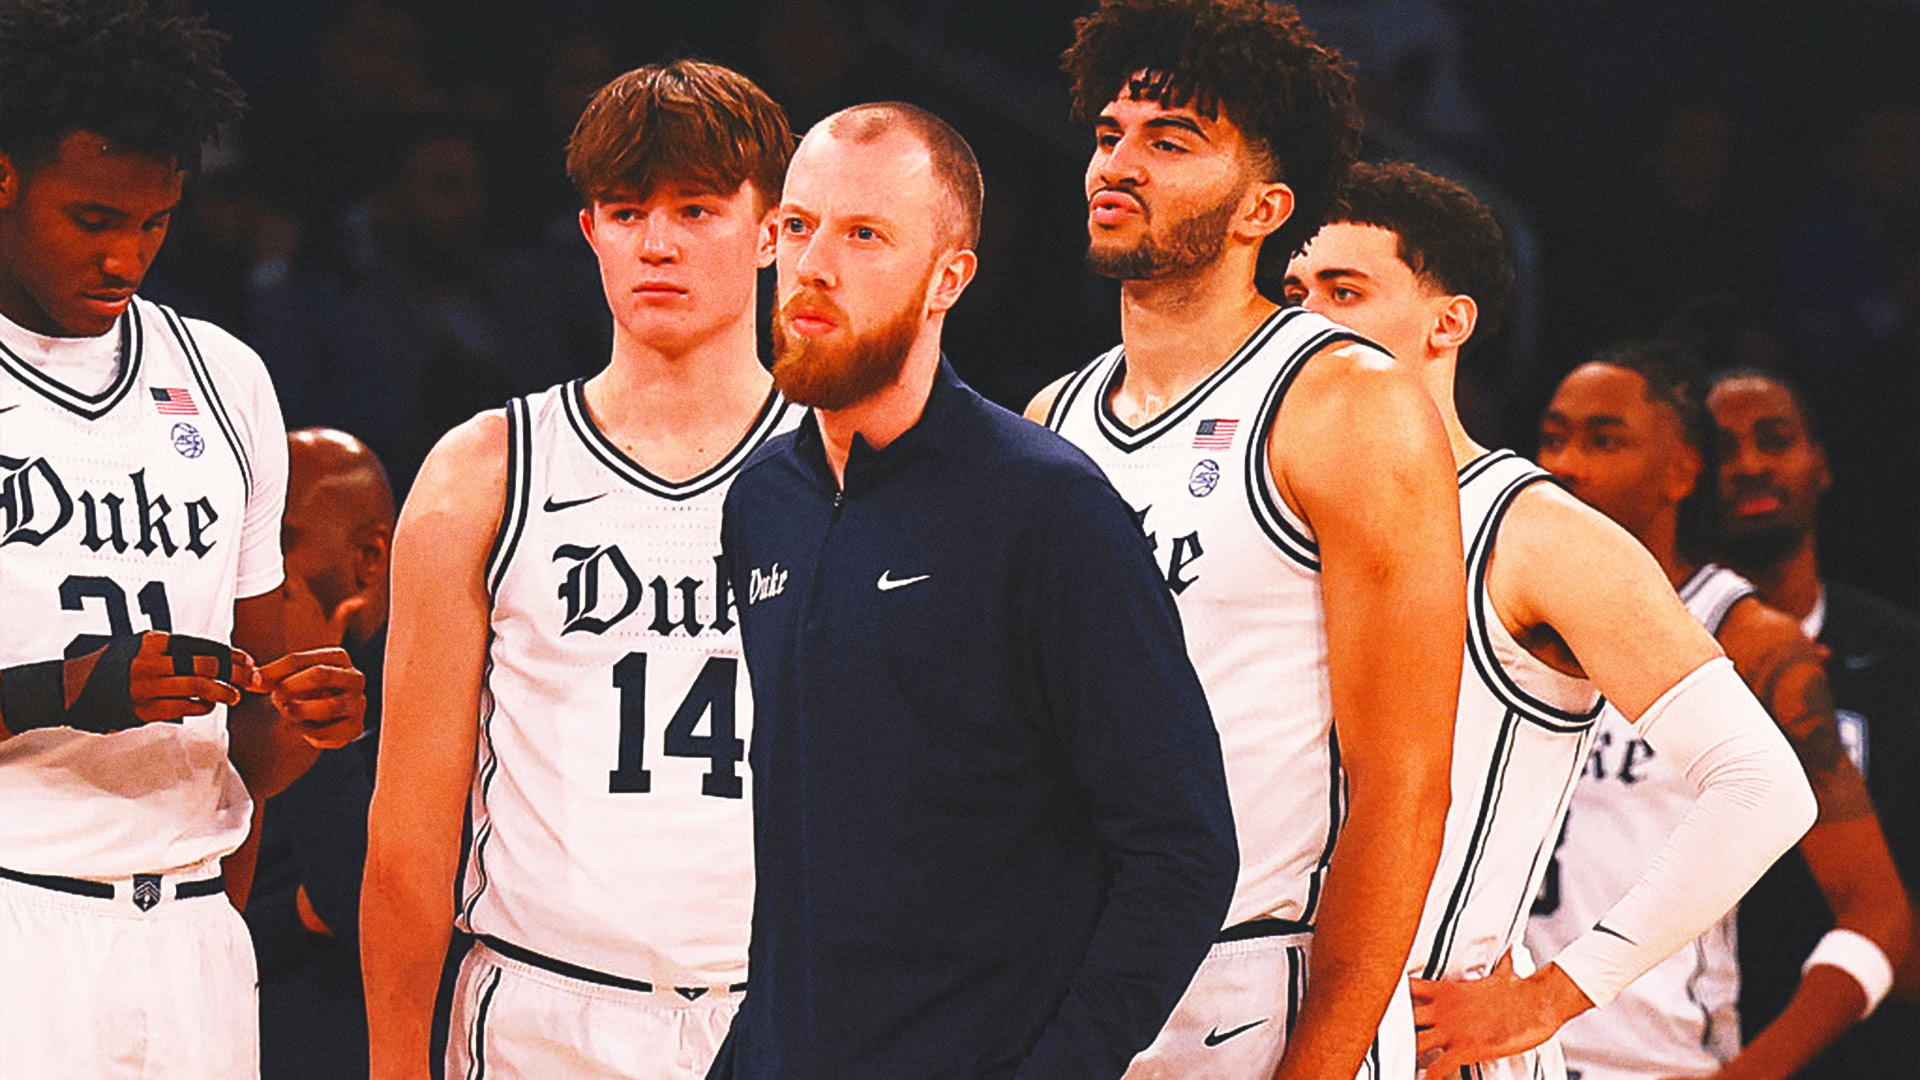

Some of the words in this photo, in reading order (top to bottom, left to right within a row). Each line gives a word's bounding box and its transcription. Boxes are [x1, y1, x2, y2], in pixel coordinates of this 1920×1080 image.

[0, 455, 219, 559] Duke
[552, 543, 736, 637] Duk
[749, 562, 788, 604] Duke
[608, 651, 745, 799] 14
